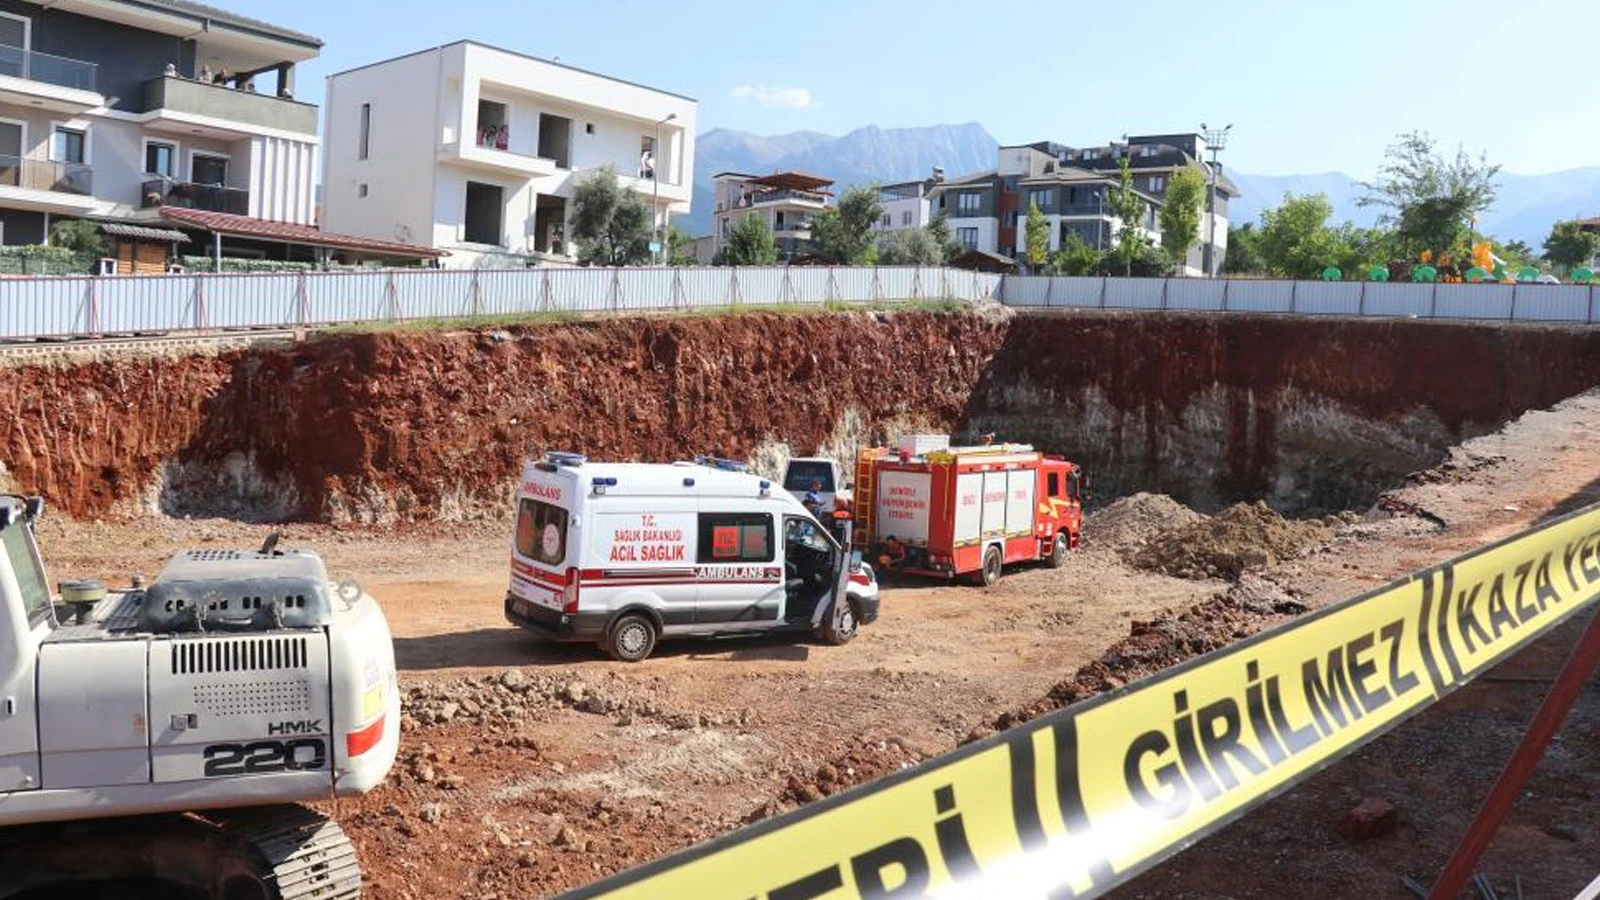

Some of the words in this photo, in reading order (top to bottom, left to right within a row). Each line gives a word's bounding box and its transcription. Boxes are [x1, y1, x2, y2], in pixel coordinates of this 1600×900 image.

[699, 567, 765, 578] AMBULANS
[1456, 552, 1563, 654] KAZA
[1563, 530, 1600, 592] YE
[268, 720, 323, 735] HMK
[1123, 618, 1420, 820] GİRİLMEZ
[203, 739, 326, 777] 220
